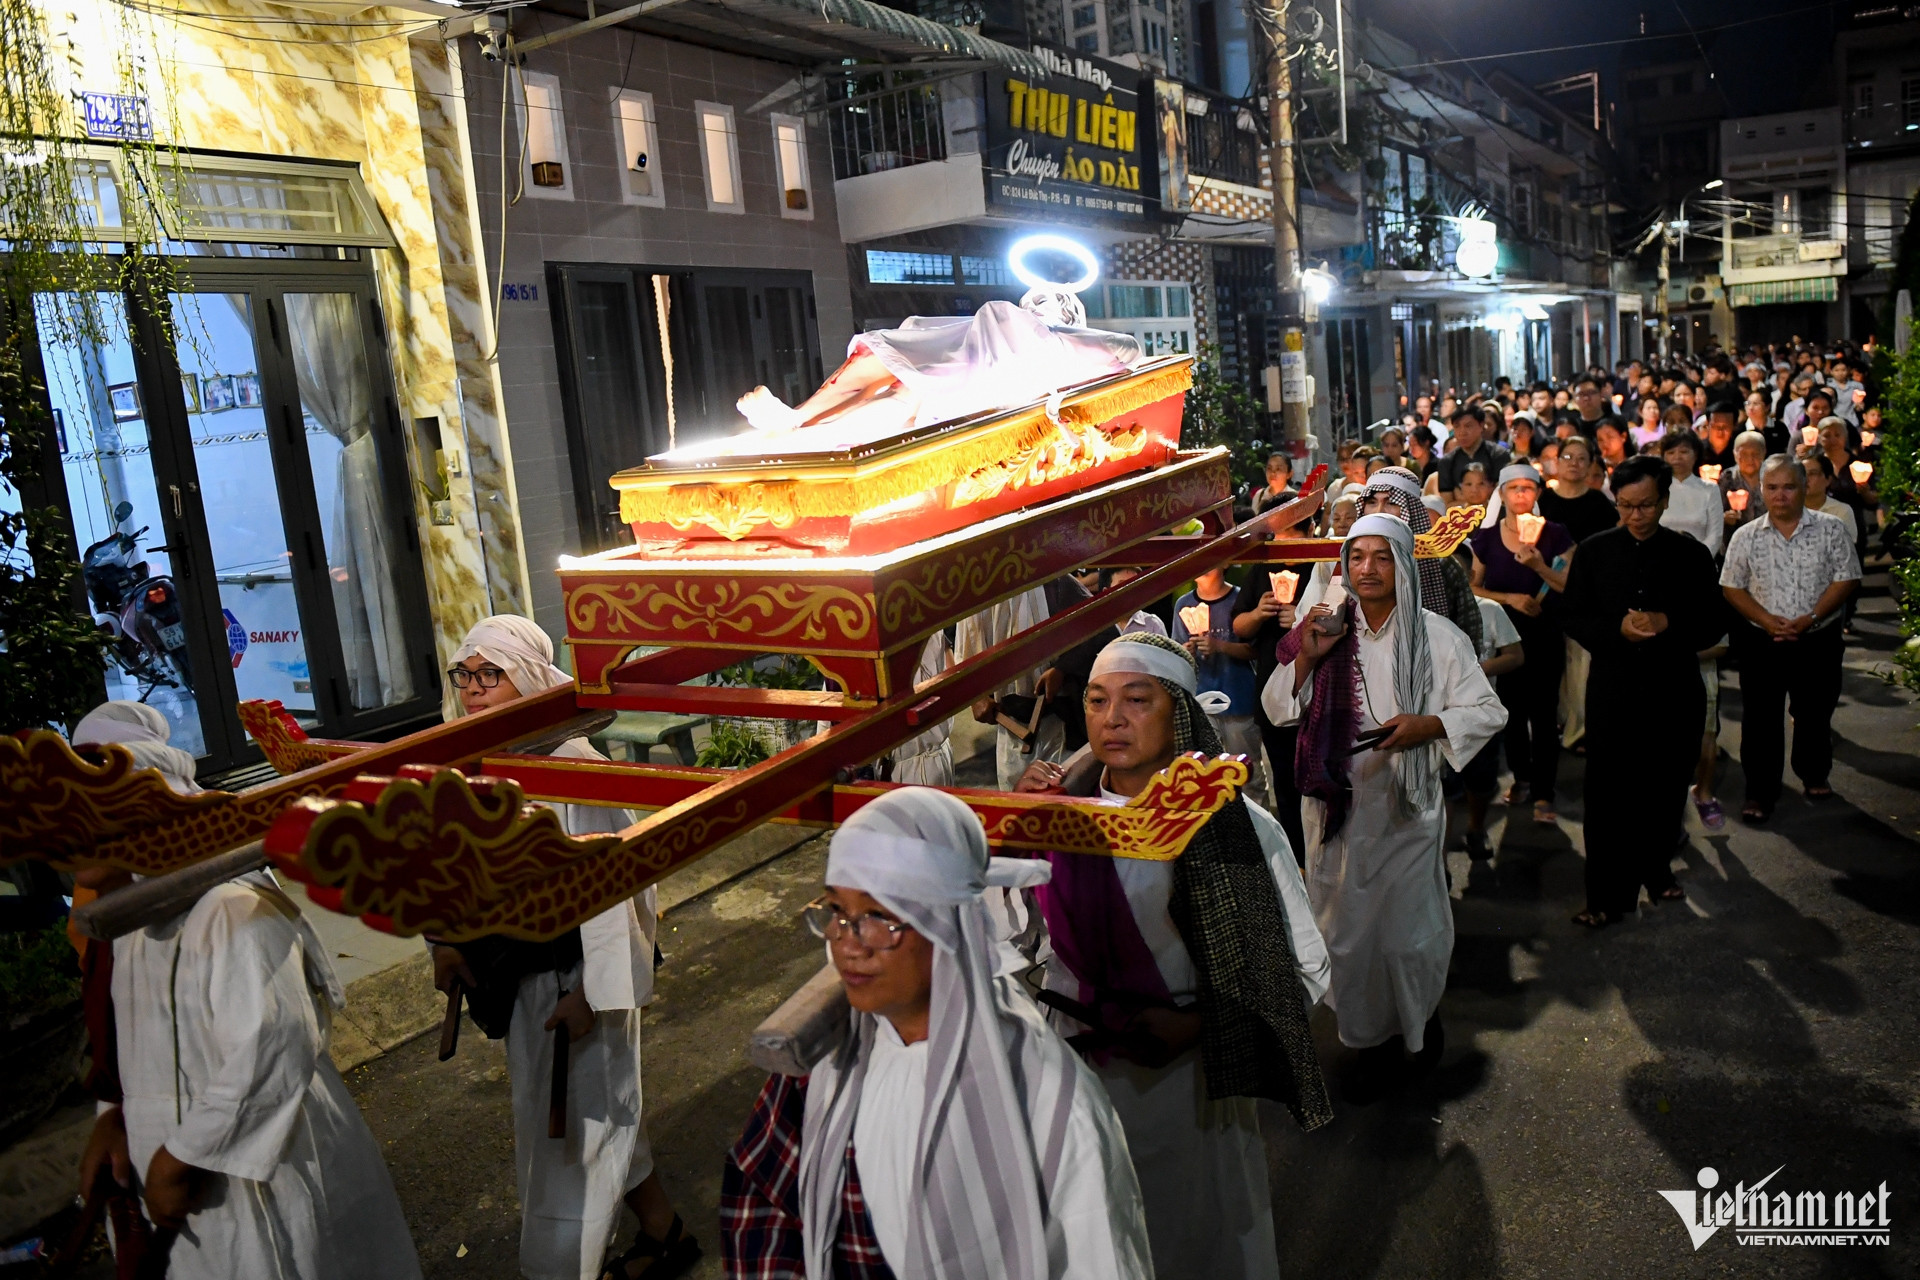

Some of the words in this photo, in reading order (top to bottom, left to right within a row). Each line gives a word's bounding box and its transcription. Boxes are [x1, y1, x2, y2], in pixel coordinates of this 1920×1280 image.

[1033, 45, 1074, 77] Nhà
[1075, 58, 1112, 91] May
[1006, 78, 1070, 138] THU
[1075, 93, 1136, 153] LIÊN
[1006, 138, 1061, 185] Chuyên
[1099, 157, 1140, 191] DÀI
[250, 630, 299, 643] SANAKY
